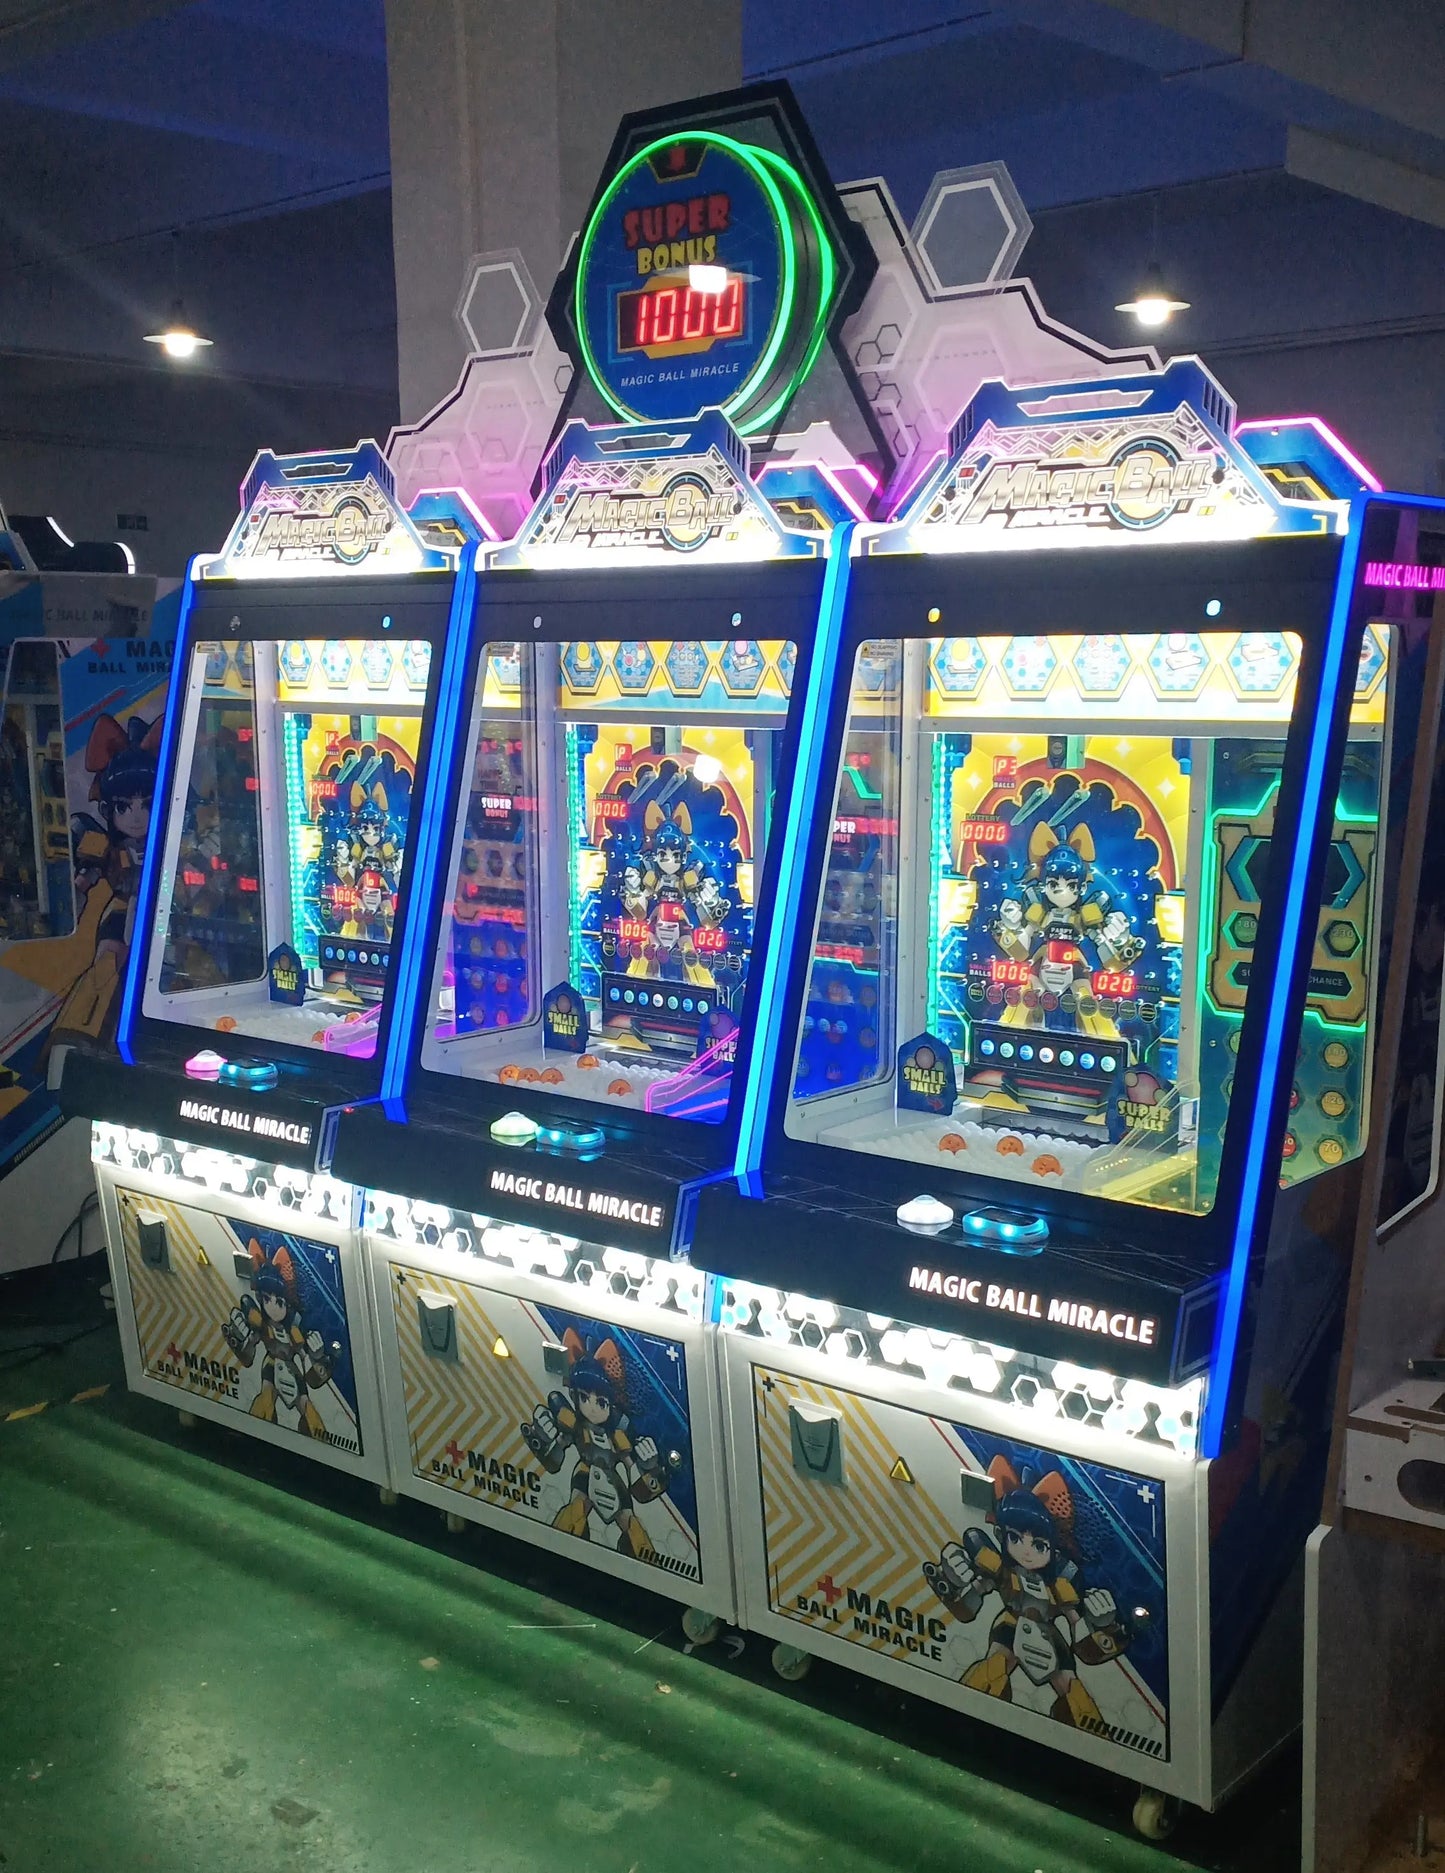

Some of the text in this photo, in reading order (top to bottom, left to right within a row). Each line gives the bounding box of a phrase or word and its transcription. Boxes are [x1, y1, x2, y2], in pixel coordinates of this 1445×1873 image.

[623, 194, 732, 247] SUPER
[637, 235, 717, 275] BONUS
[636, 280, 740, 344] 1000
[621, 362, 740, 387] MAGIC BALL MIRACLE
[961, 456, 1213, 524] MAGIC BALL
[558, 490, 733, 541] MAGIC BALL
[254, 514, 335, 555] MAGIC
[1364, 562, 1403, 586] MAGIC
[1403, 565, 1429, 588] BALL
[88, 661, 126, 674] BALL
[481, 797, 512, 810] SUPER
[966, 813, 1001, 822] LOTTERY
[833, 821, 856, 833] PER
[969, 969, 991, 978] BALLS
[1097, 974, 1134, 996] 020
[547, 1011, 580, 1027] SMALL
[553, 1023, 577, 1036] BALLS
[903, 1067, 946, 1085] SMALL
[910, 1080, 943, 1095] BALLS
[180, 1100, 310, 1145] MAGIC BALL MIRACLE
[1117, 1100, 1170, 1122] SUPER
[1125, 1115, 1164, 1132] BALLS
[1323, 1143, 1340, 1153] 70
[490, 1171, 662, 1227] MAGIC BALL MIRACLE
[909, 1266, 1155, 1345] MAGIC BALL MIRACLE
[157, 1359, 239, 1400] BALL MIRACLE
[183, 1350, 240, 1385] MAGIC
[431, 1459, 540, 1510] BALL MIRACLE
[467, 1450, 541, 1493] MAGIC
[796, 1594, 943, 1662] BALL MIRACLE
[846, 1586, 947, 1643] MAGIC
